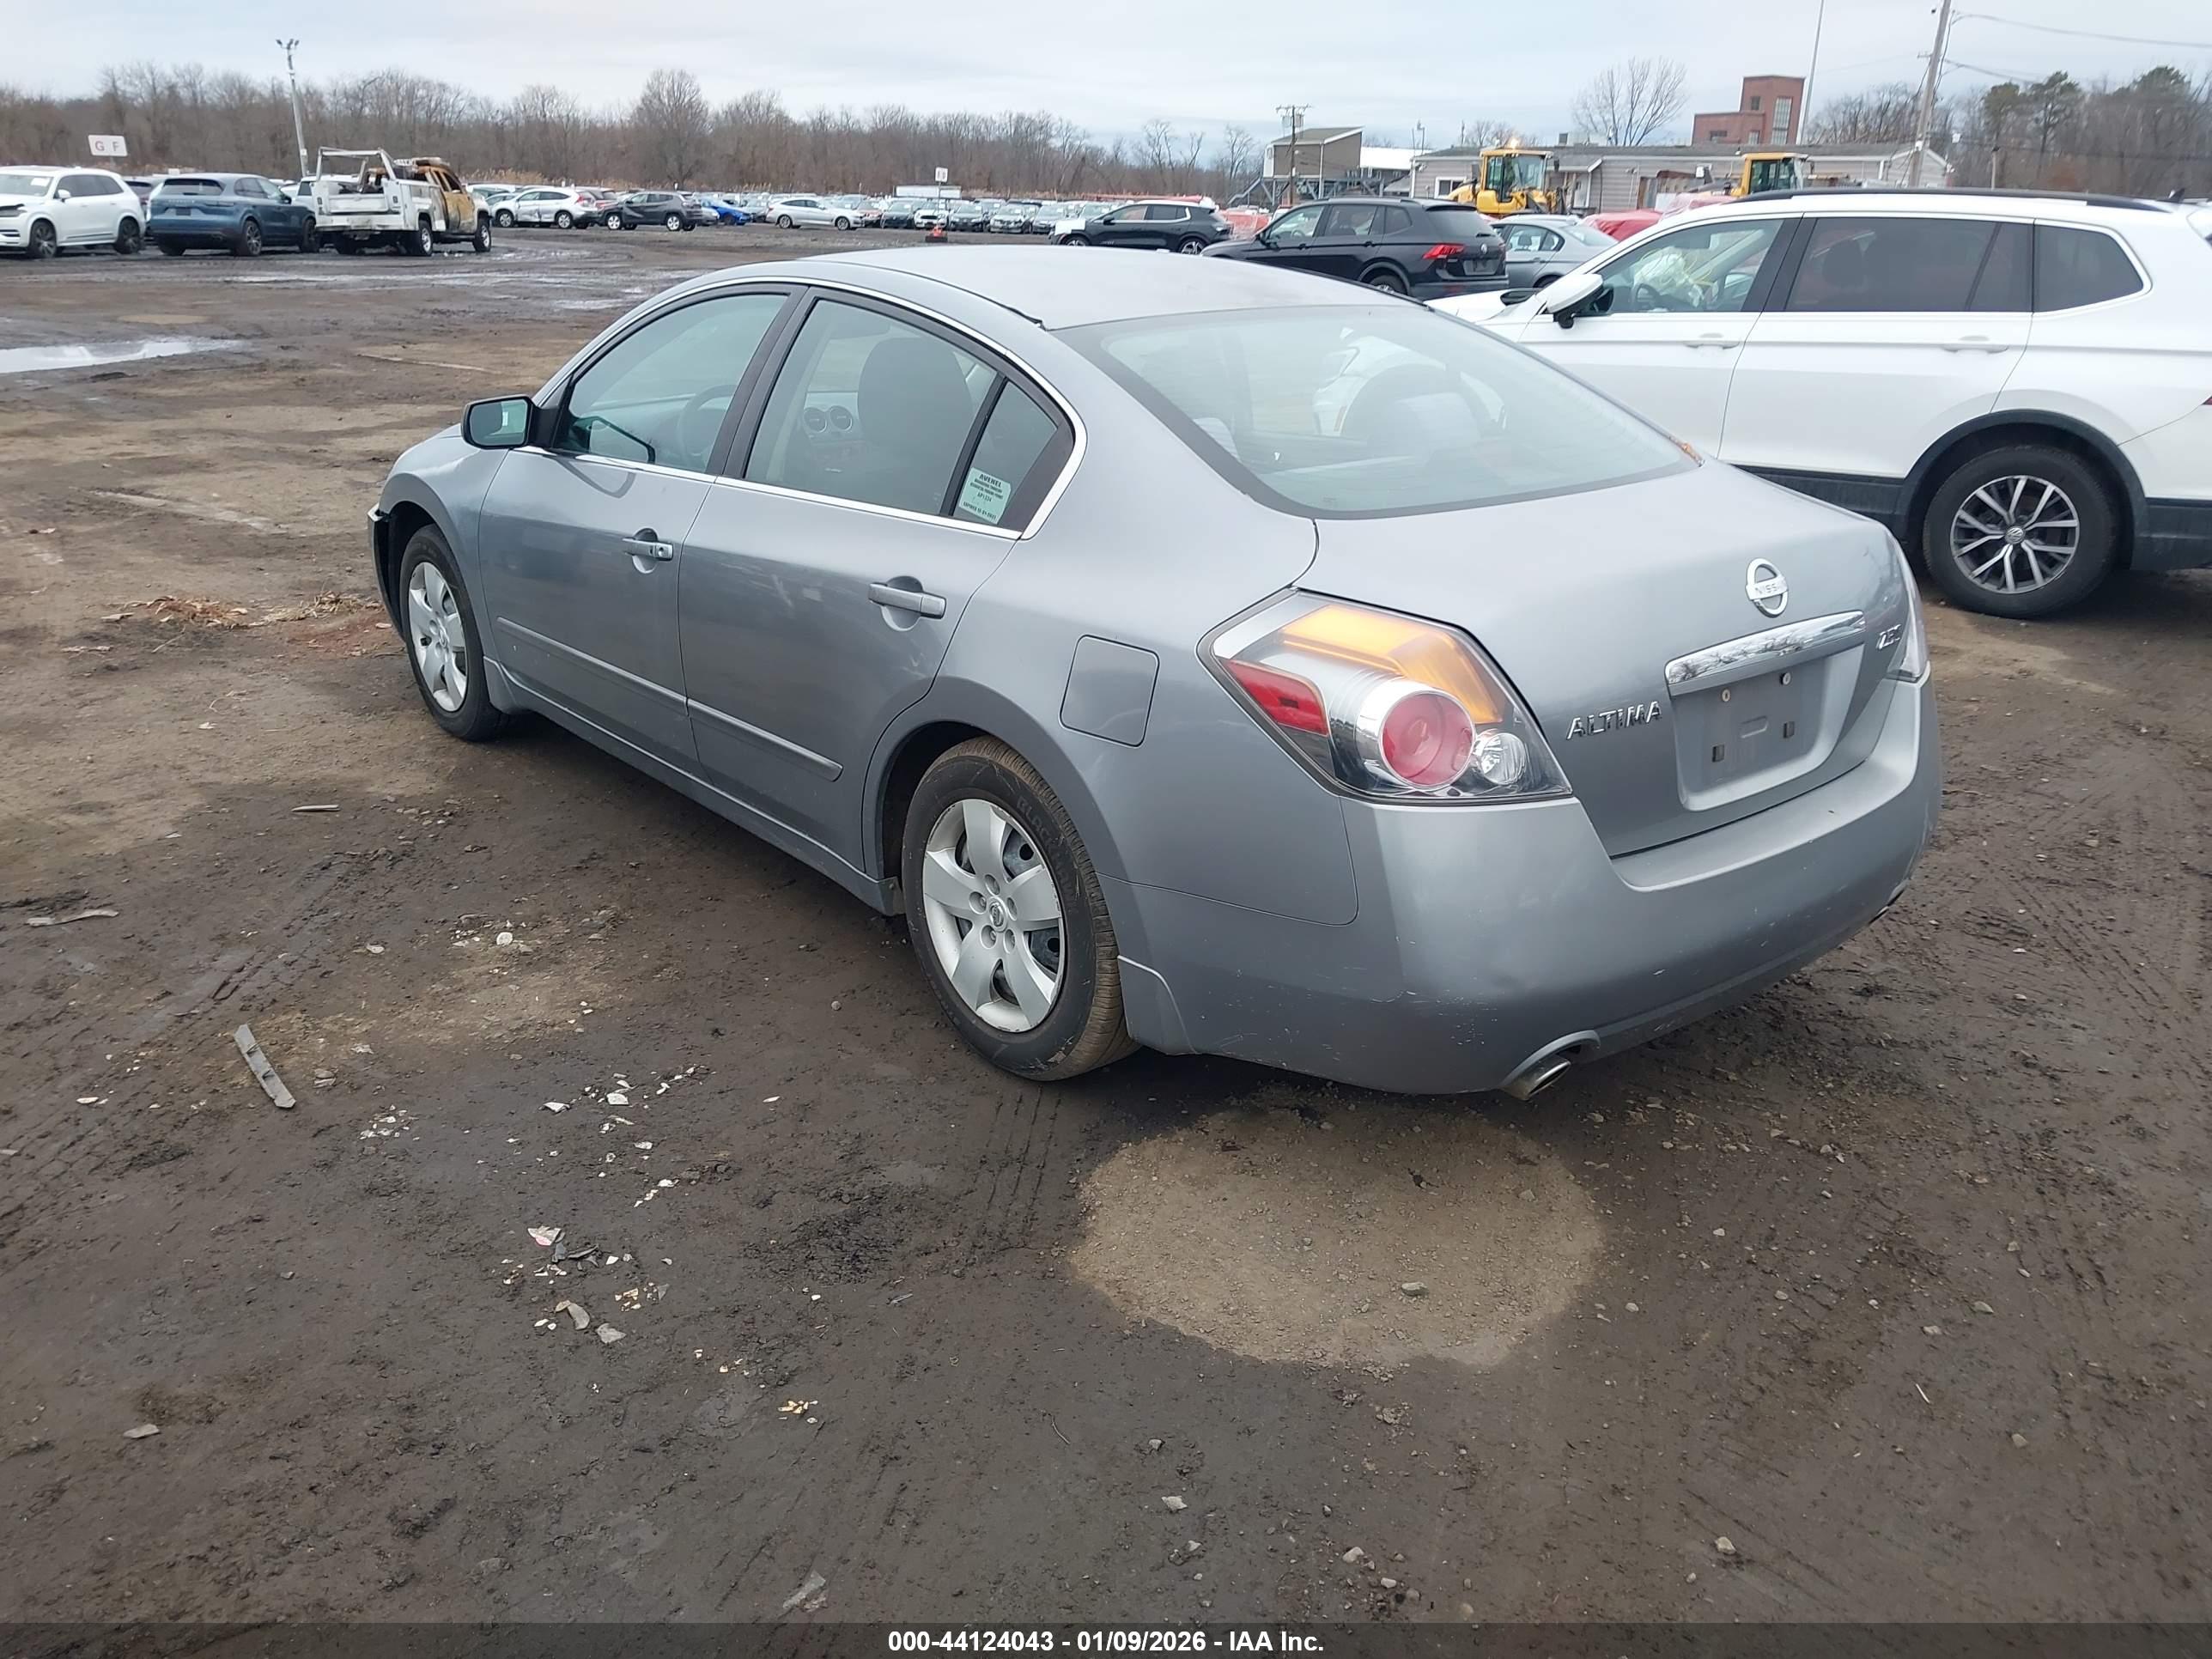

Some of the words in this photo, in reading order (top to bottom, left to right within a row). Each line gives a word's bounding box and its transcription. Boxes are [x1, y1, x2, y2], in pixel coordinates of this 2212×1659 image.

[94, 141, 105, 151] G
[112, 141, 119, 152] F
[1566, 701, 1662, 740] ALTIMA
